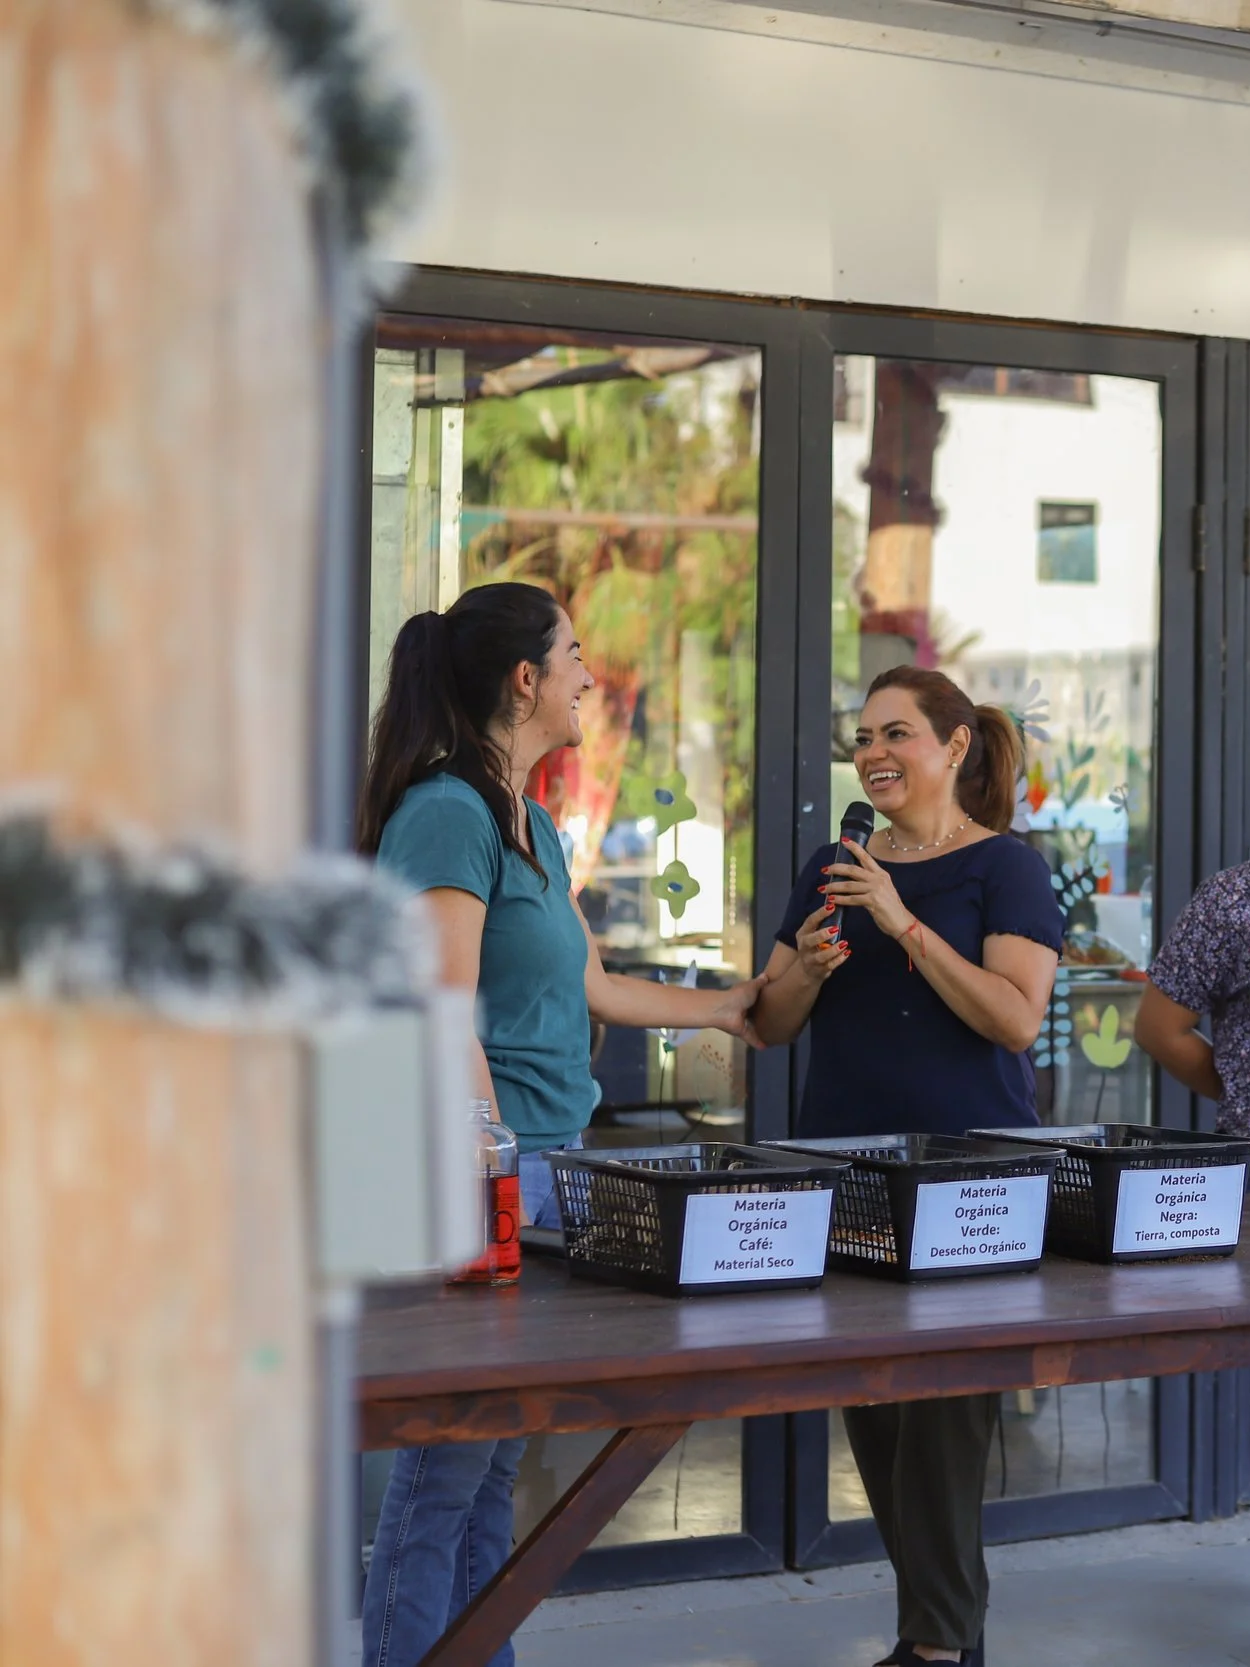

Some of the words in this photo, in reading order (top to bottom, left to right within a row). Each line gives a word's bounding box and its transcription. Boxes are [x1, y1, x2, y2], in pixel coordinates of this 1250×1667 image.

[1160, 1173, 1206, 1186] Materia
[960, 1184, 1007, 1199] Materia
[734, 1198, 786, 1212] Materia
[1155, 1192, 1207, 1206] Orgánica
[954, 1205, 1009, 1220] Orgánica
[1160, 1211, 1198, 1224] Negra:
[728, 1218, 787, 1234] Orgánica
[961, 1224, 1000, 1237] Verde:
[1135, 1231, 1168, 1242] Tierra,
[1170, 1226, 1220, 1239] composta
[739, 1237, 773, 1251] Café:
[930, 1244, 976, 1258] Desecho
[979, 1240, 1026, 1255] Orgánico
[714, 1257, 764, 1271] Material
[767, 1257, 794, 1268] Seco
